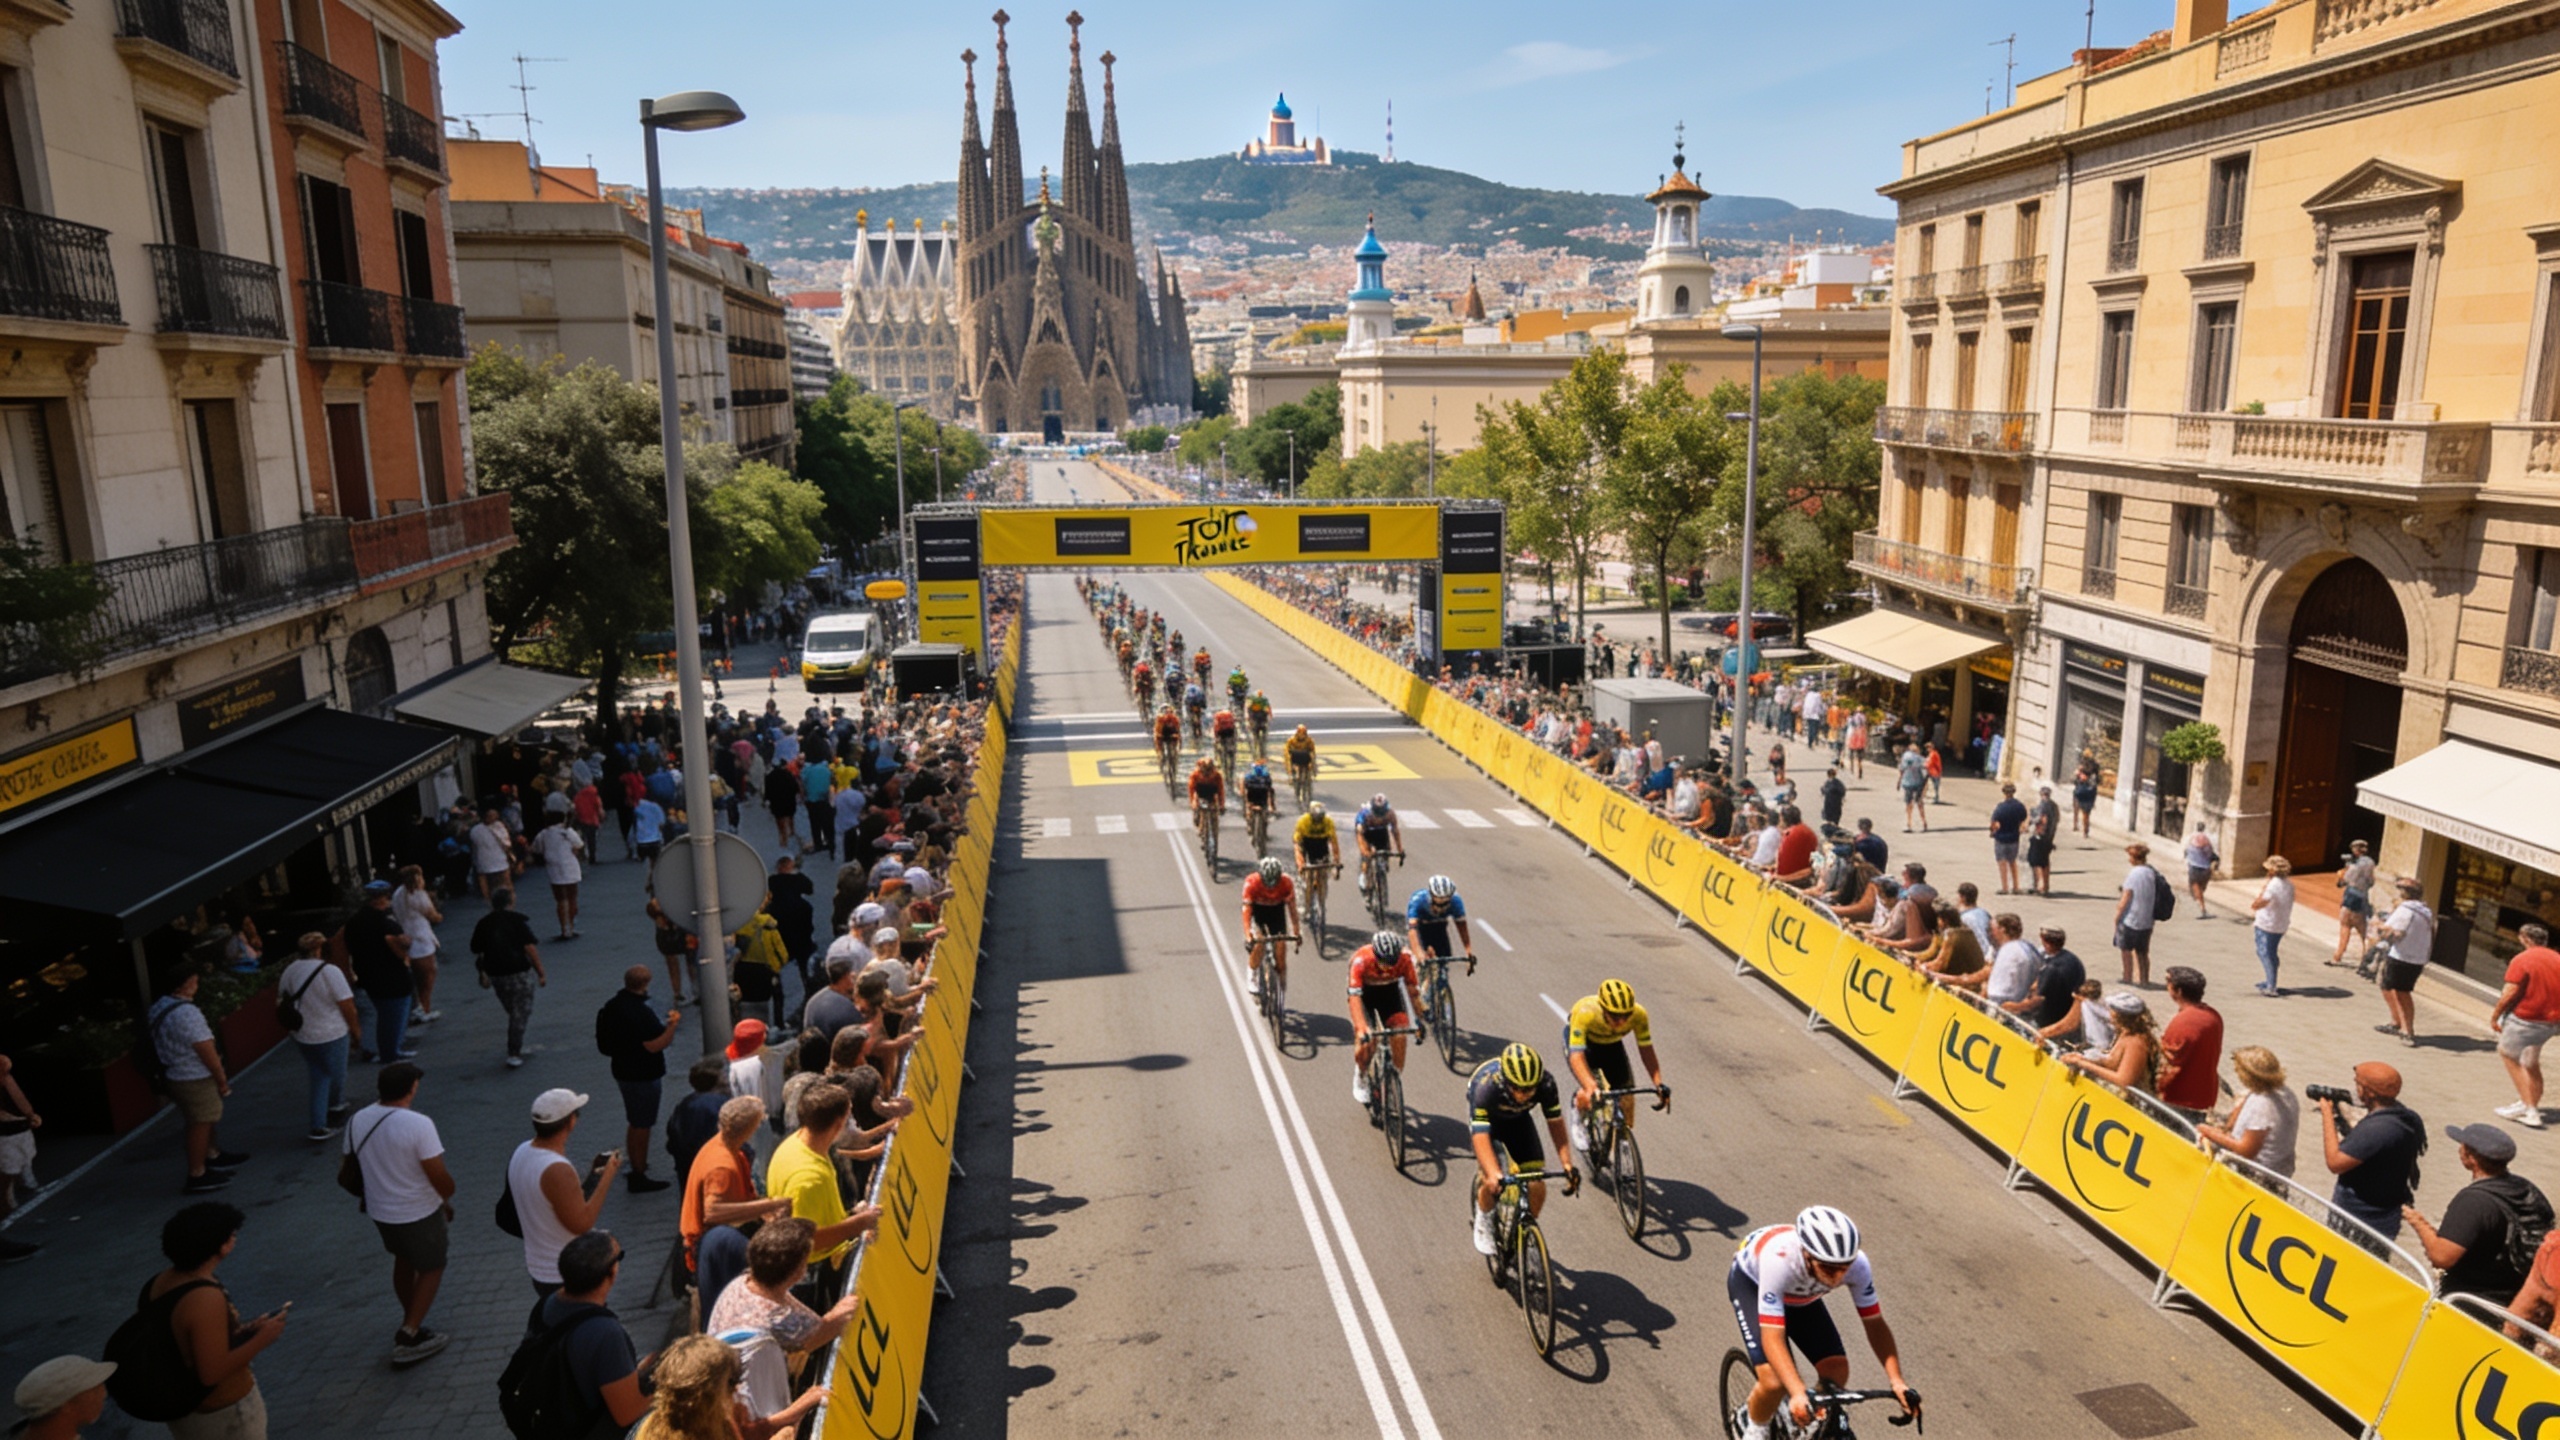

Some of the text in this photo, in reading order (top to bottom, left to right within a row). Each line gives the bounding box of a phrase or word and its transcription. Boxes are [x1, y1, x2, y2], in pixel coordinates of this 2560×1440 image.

[1703, 865, 1735, 906] LCL
[1771, 907, 1809, 954] LCL
[1849, 958, 1896, 1014] LCL
[1945, 1019, 2006, 1090] LCL
[2072, 1101, 2152, 1189] LCL
[2238, 1212, 2349, 1325] LCL
[849, 1297, 889, 1418] LCL
